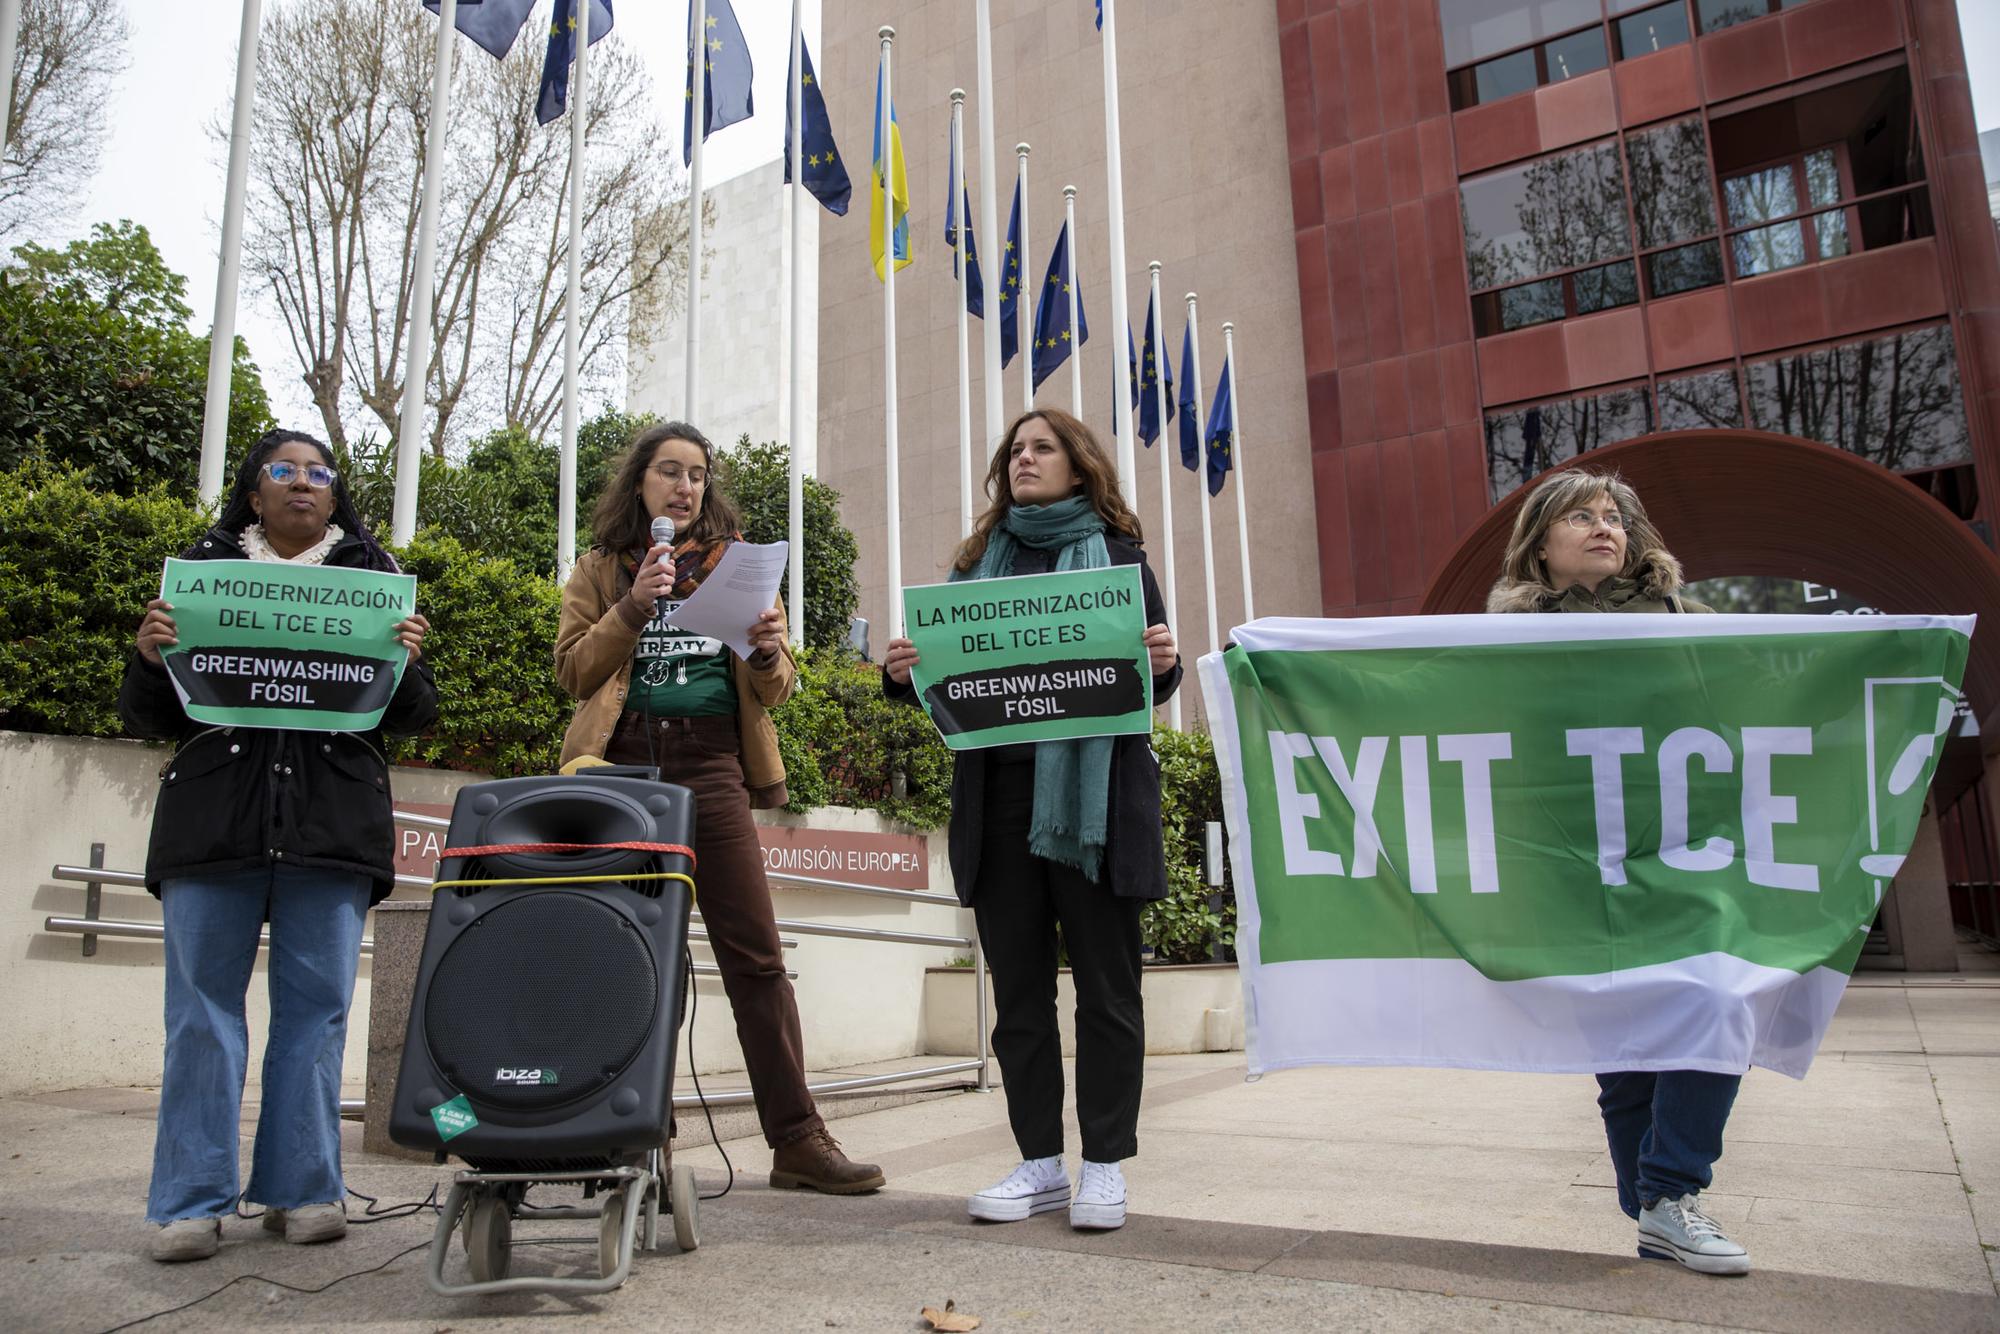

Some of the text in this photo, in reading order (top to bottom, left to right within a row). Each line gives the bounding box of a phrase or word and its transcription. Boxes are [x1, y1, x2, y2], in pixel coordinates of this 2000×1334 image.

[175, 578, 403, 610] LA MODERNIZACIÓN
[917, 586, 1131, 627] LA MODERNIZACIÓN
[219, 608, 353, 636] DEL TCE ES
[638, 641, 706, 653] TREATY
[961, 623, 1087, 654] DEL TCE ES
[191, 653, 375, 683] GREENWASHING
[250, 682, 316, 704] FÓSIL
[947, 666, 1117, 701] GREENWASHING
[1003, 696, 1066, 719] FÓSIL
[1267, 726, 1821, 894] EXIT TCE
[402, 830, 448, 858] PA
[760, 844, 920, 873] COMISIÓN EUROPEA
[496, 1067, 542, 1080] ibiza
